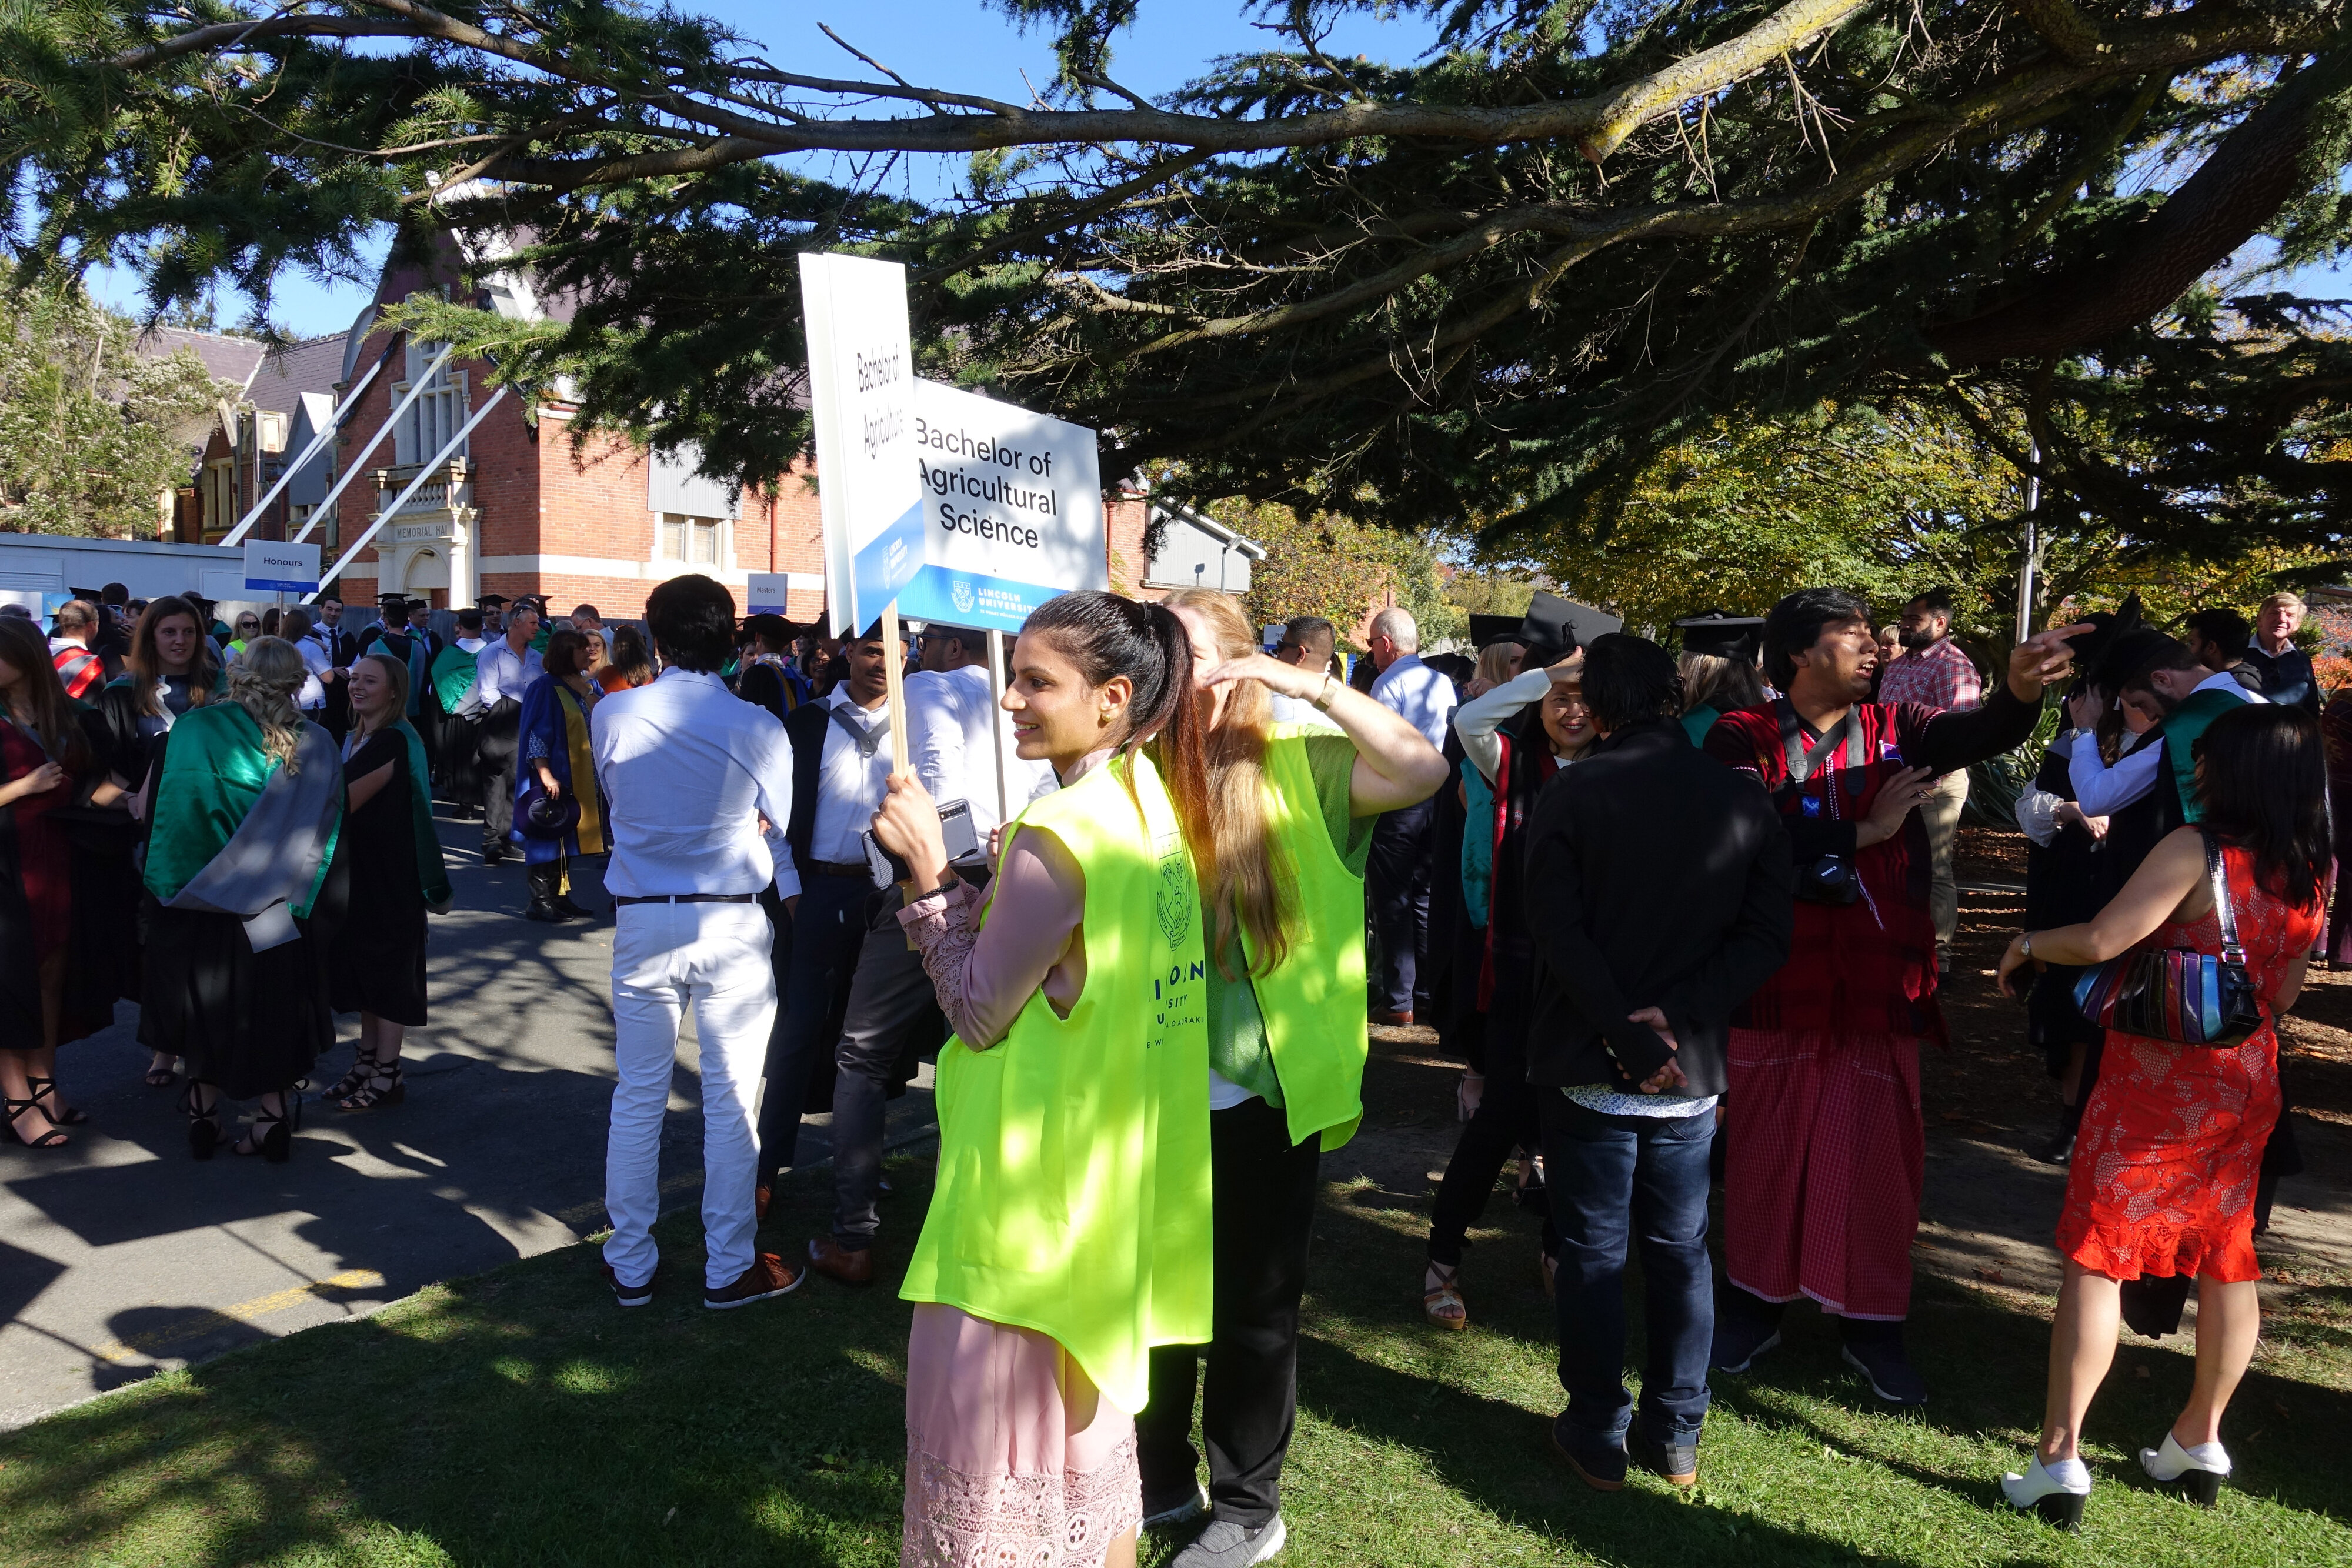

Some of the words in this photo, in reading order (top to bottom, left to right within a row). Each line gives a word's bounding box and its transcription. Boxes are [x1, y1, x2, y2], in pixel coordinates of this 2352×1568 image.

[857, 345, 891, 392] Bachelor
[893, 343, 899, 381] of
[864, 402, 903, 459] Agriculture
[916, 417, 1022, 469] Bachelor
[1029, 452, 1052, 478] of
[919, 458, 1057, 516] Agricultural
[397, 526, 433, 539] MEMORIAL
[940, 503, 1039, 548] Science
[263, 557, 303, 566] Honours
[978, 587, 1021, 603] LINCOLN
[1821, 866, 1837, 876] Canon
